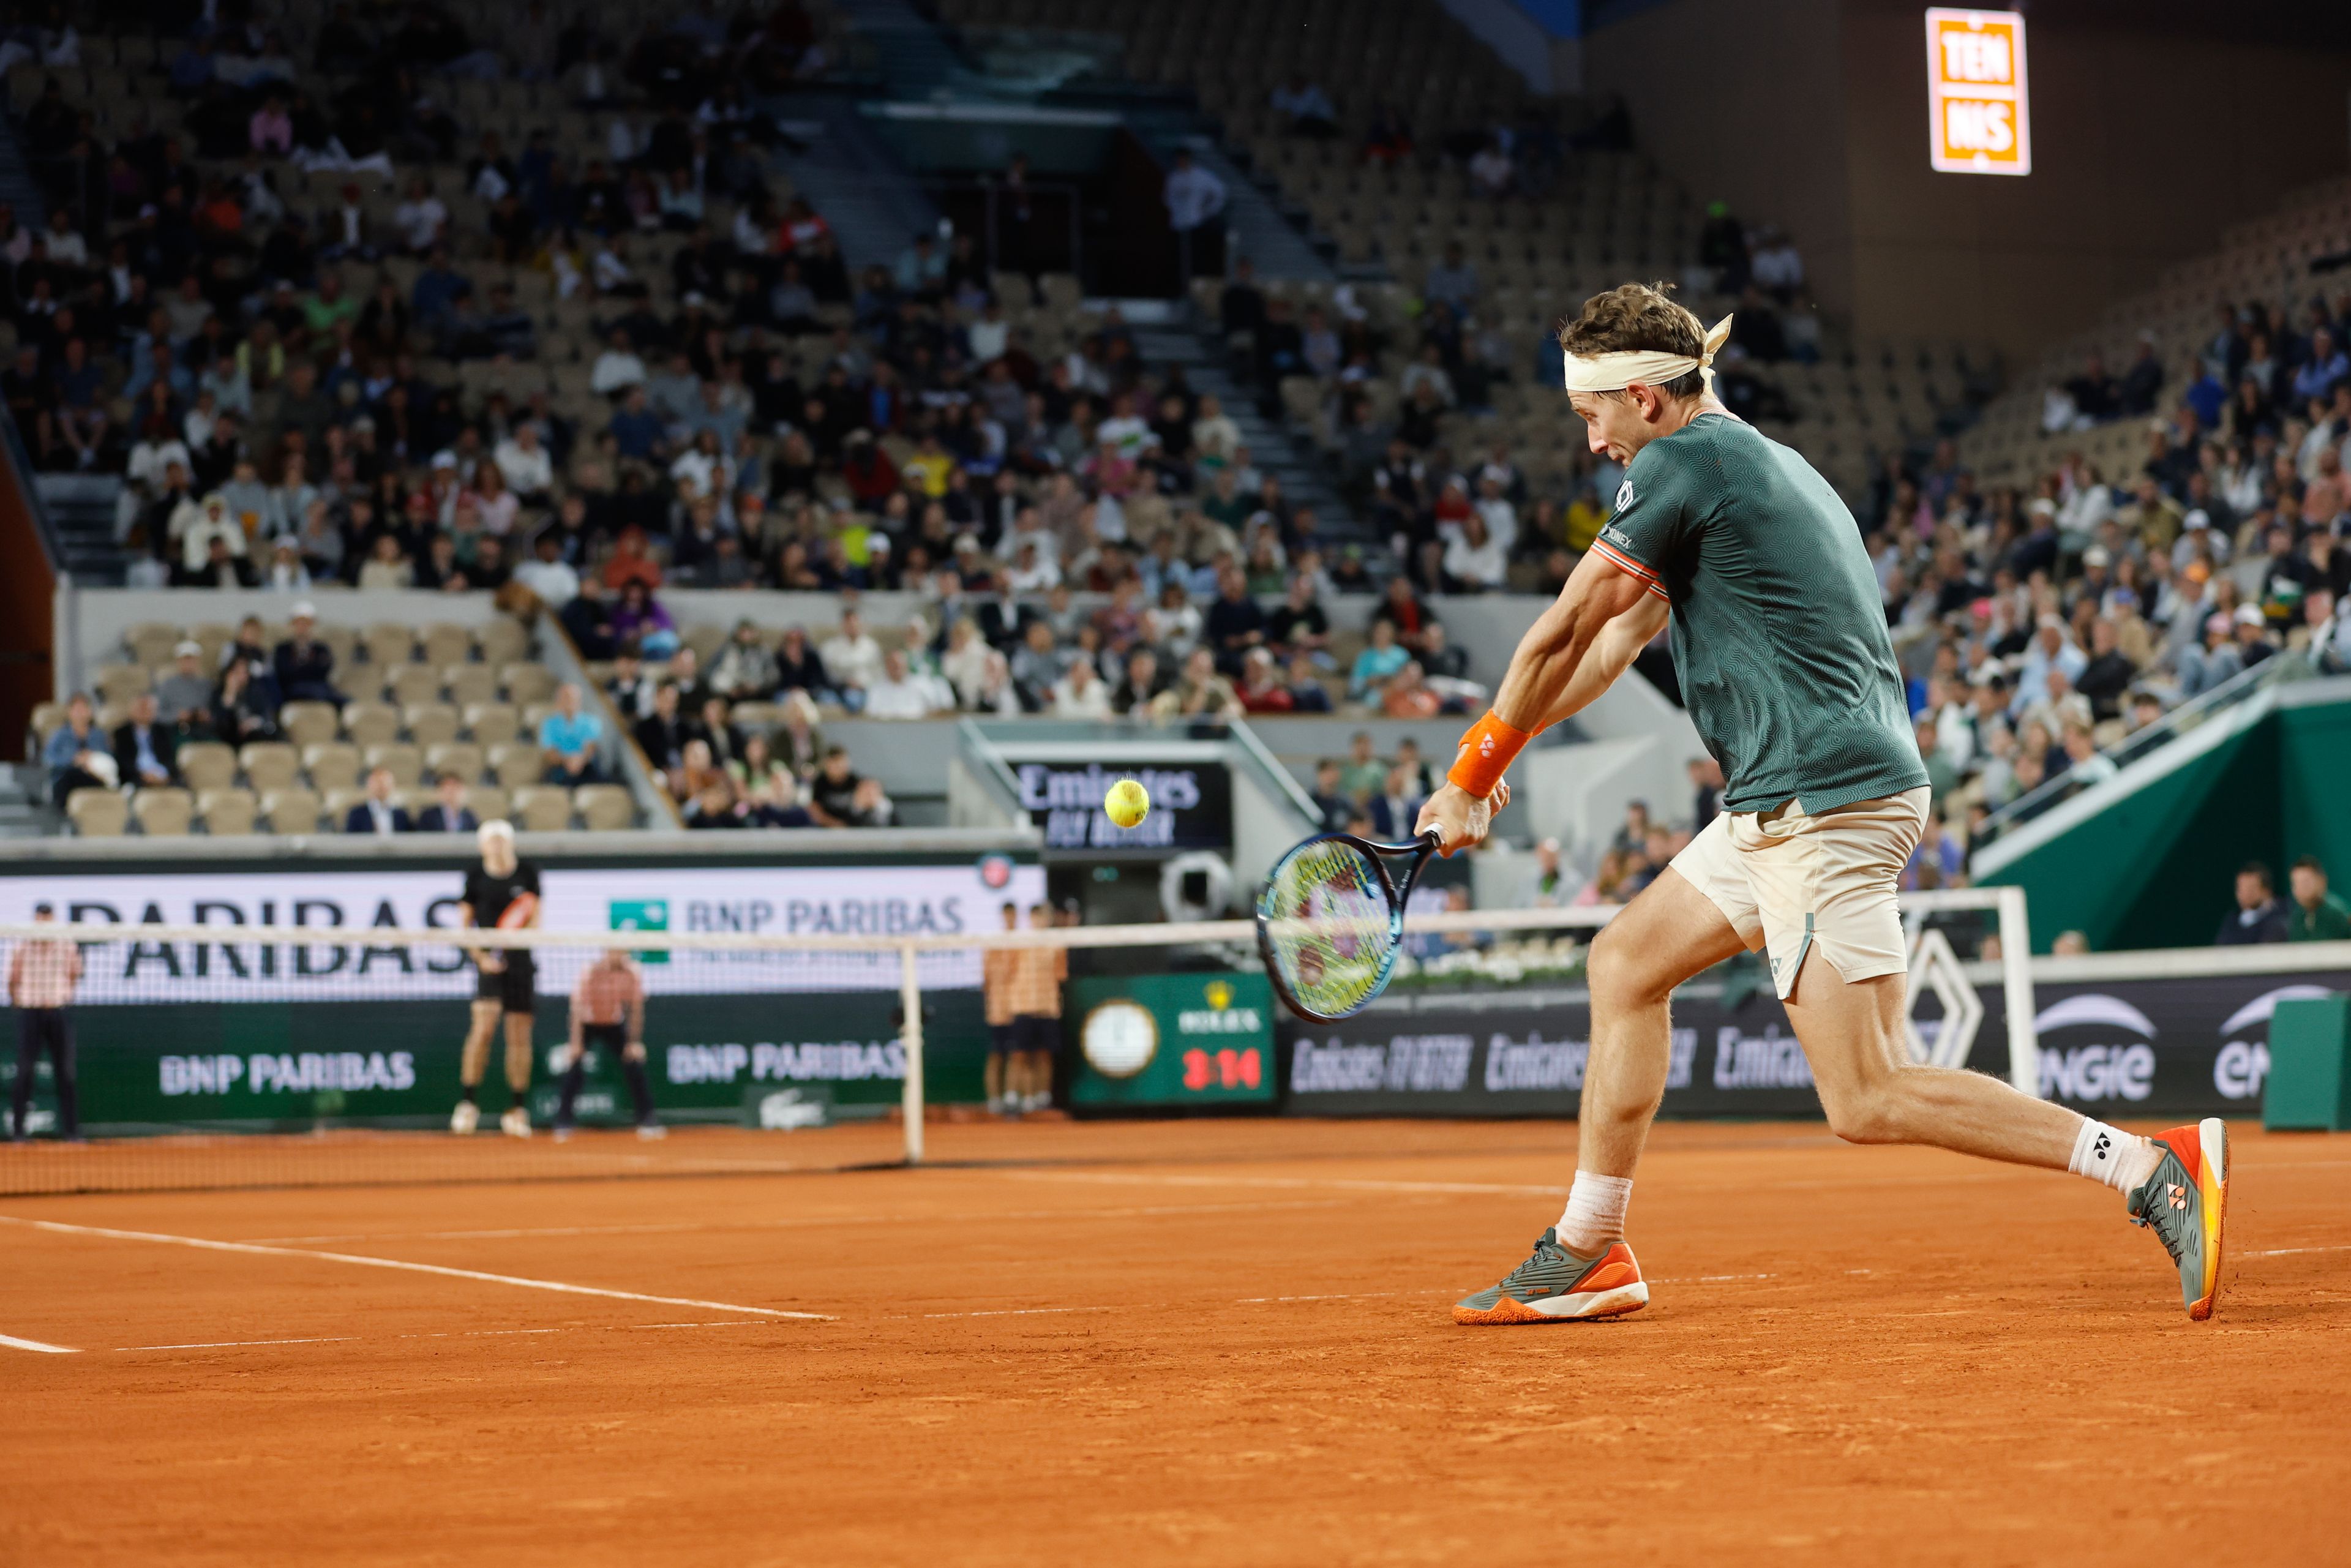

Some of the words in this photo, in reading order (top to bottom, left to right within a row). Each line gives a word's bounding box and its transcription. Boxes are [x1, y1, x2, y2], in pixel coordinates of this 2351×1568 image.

[1941, 31, 2010, 82] TEN
[1947, 99, 2013, 152] NIS
[1608, 526, 1632, 549] YONEX
[686, 898, 774, 932] BNP
[787, 896, 964, 935] PARIBAS
[69, 901, 469, 978] PARIBAS
[159, 1054, 244, 1095] BNP
[247, 1051, 416, 1094] PARIBAS
[667, 1043, 748, 1084] BNP
[751, 1040, 907, 1081] PARIBAS
